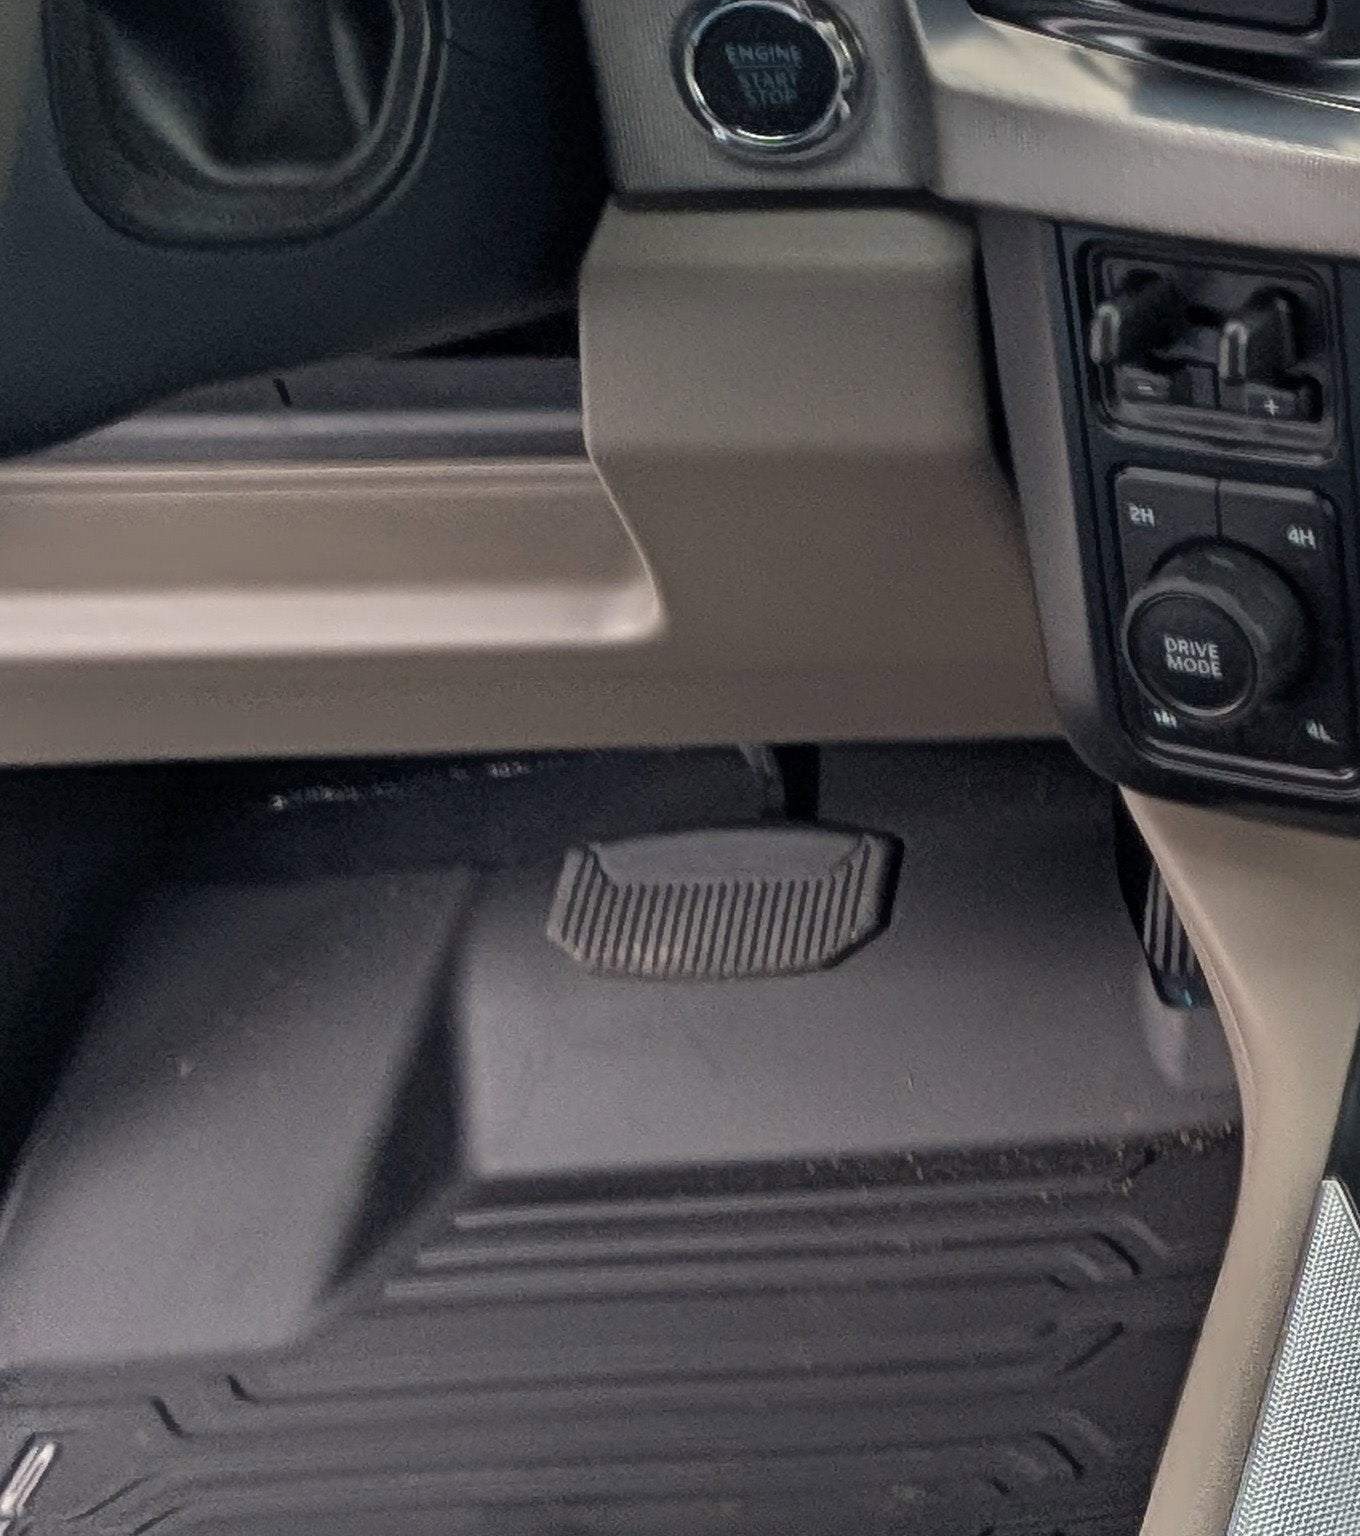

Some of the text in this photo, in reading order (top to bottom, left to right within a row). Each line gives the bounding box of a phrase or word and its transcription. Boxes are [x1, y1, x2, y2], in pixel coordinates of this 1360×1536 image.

[725, 43, 800, 63] ENGINE
[1288, 526, 1316, 549] 4H
[1164, 636, 1219, 659] DRIVE
[1166, 655, 1223, 679] MODE
